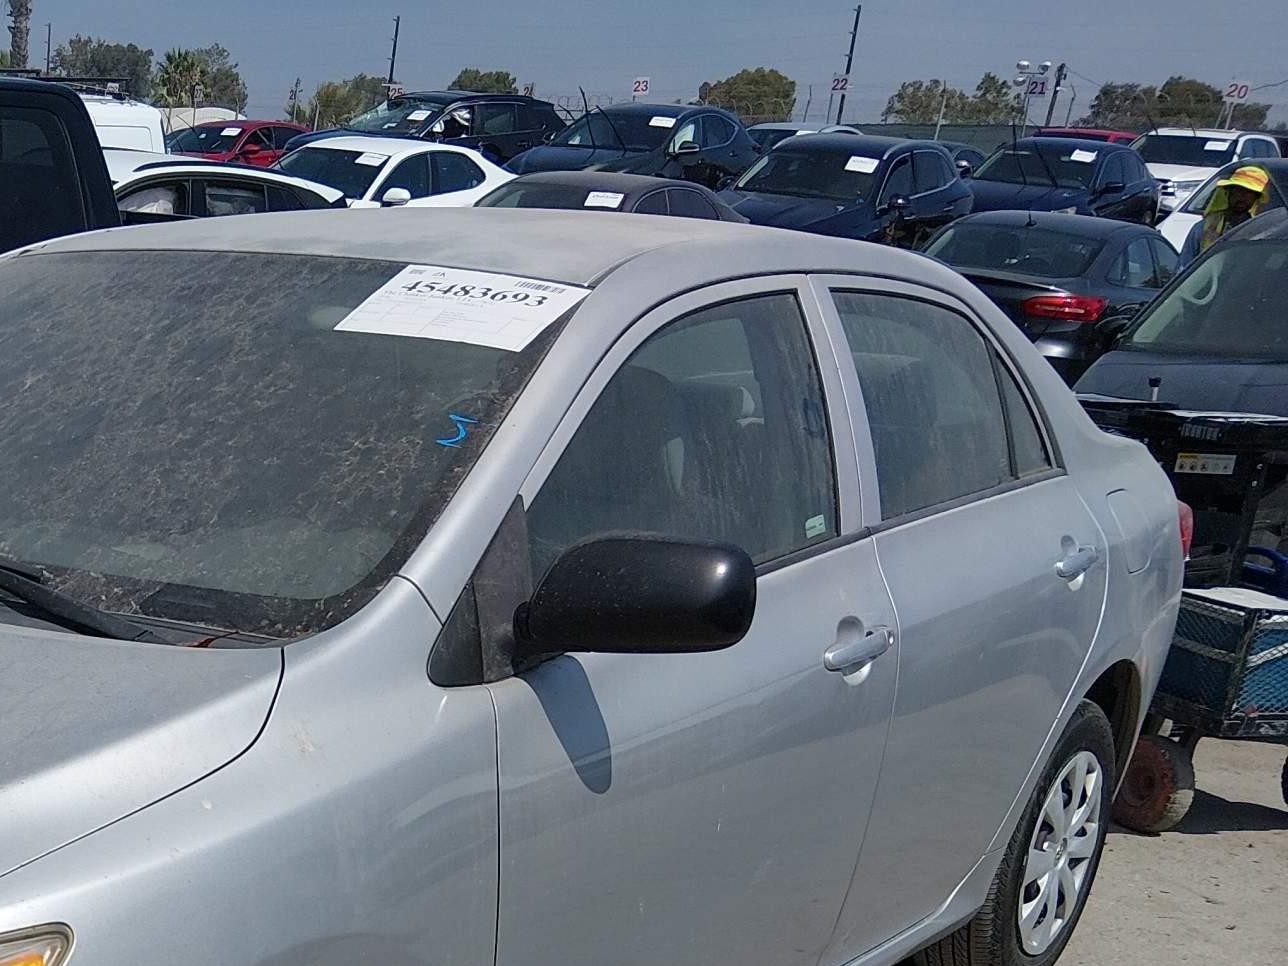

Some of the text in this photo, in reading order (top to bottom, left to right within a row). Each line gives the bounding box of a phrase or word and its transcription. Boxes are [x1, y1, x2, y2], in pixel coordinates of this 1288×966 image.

[633, 80, 648, 92] 23
[832, 78, 848, 90] 22
[1028, 81, 1046, 94] 21
[390, 87, 403, 98] 25
[1225, 83, 1249, 99] 20
[401, 280, 548, 307] 45483693
